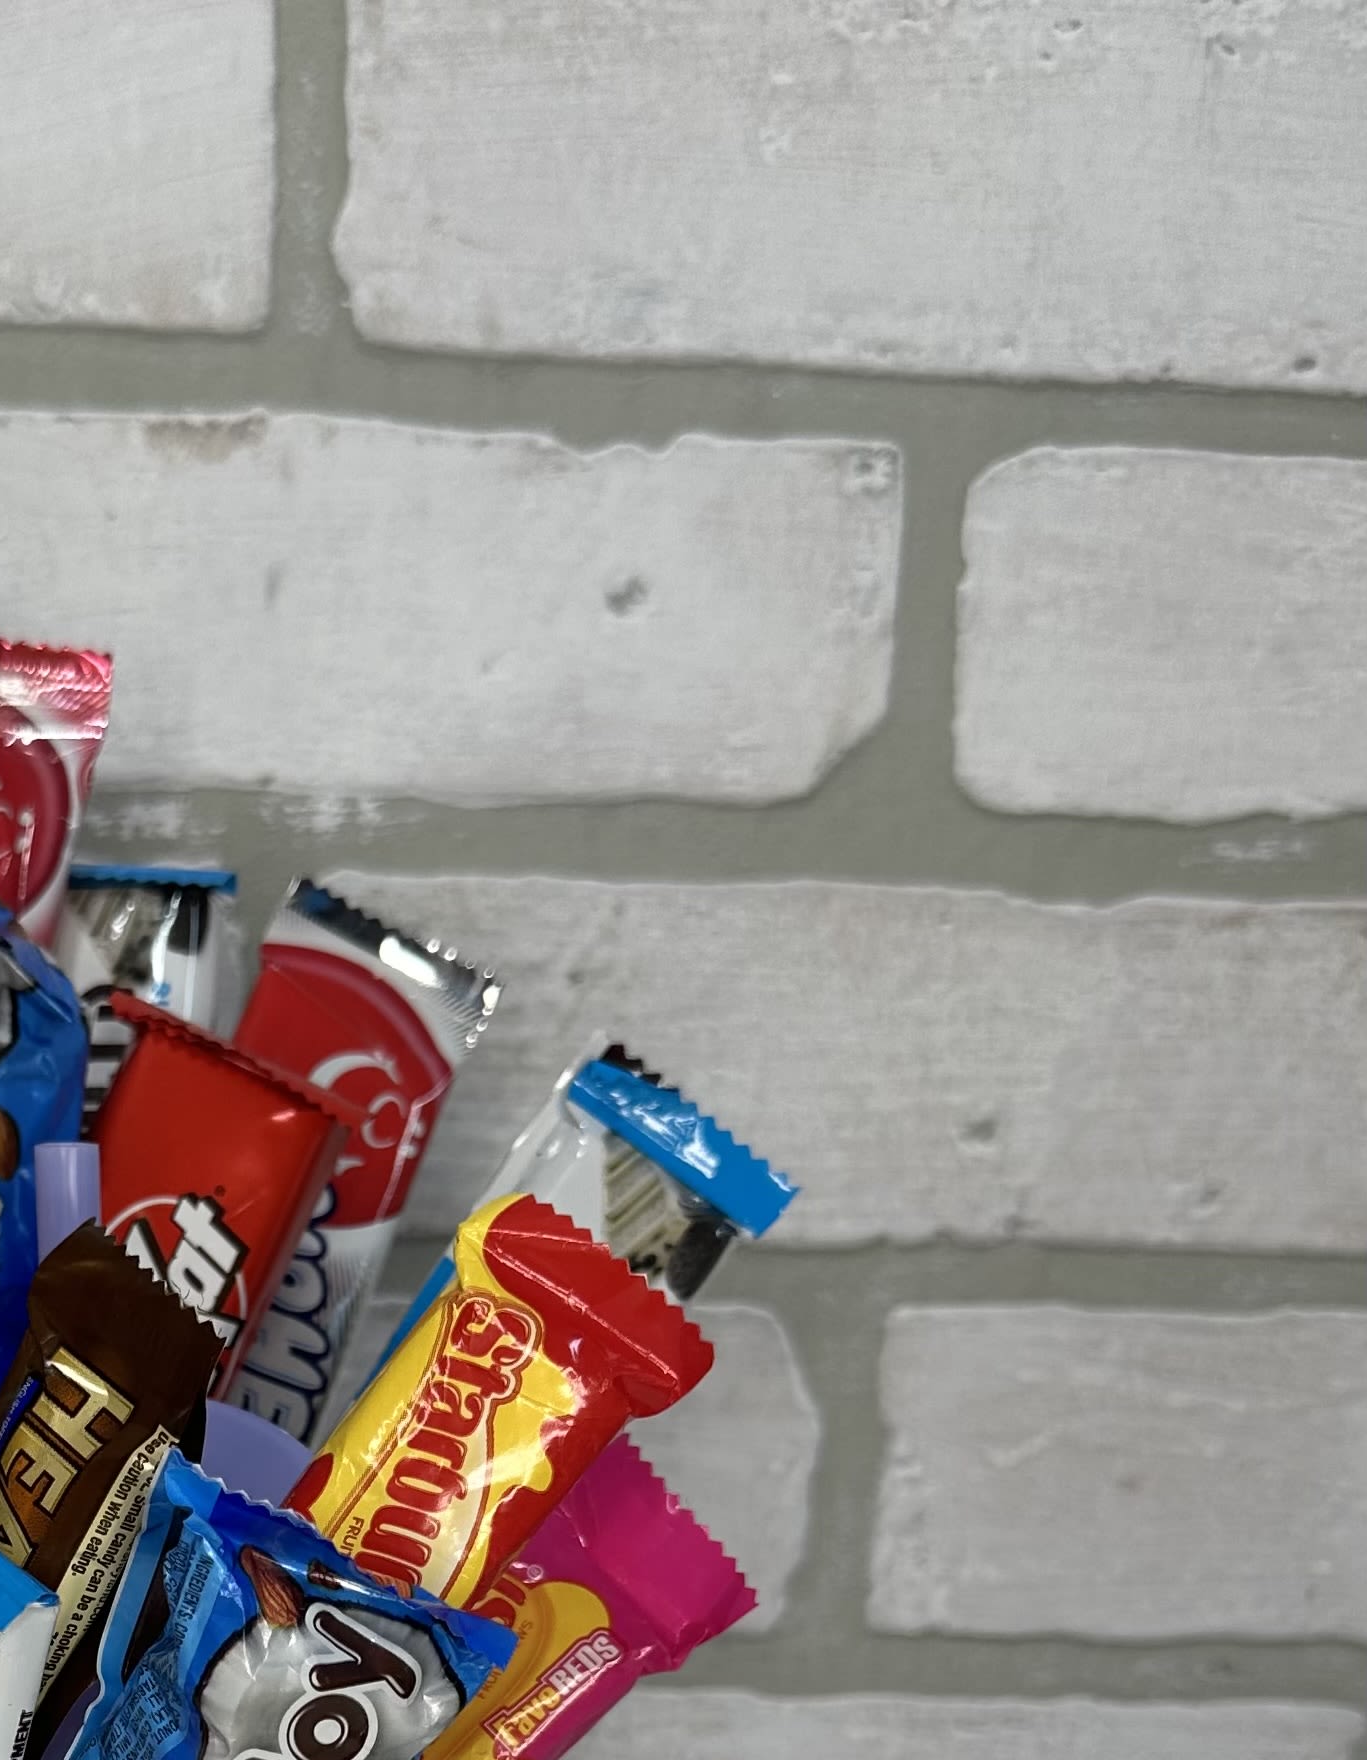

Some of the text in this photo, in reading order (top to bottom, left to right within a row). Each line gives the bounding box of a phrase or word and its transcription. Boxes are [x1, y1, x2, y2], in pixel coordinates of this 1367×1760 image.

[144, 1431, 170, 1455] Use
[95, 1500, 125, 1538] when
[119, 1495, 149, 1532] small
[96, 1533, 129, 1571] candy
[341, 1517, 364, 1556] FRUI
[70, 1538, 103, 1574] eating.
[85, 1569, 107, 1593] can
[176, 1553, 214, 1622] INGREDIENTS:
[76, 1594, 95, 1611] be
[44, 1624, 79, 1672] choking
